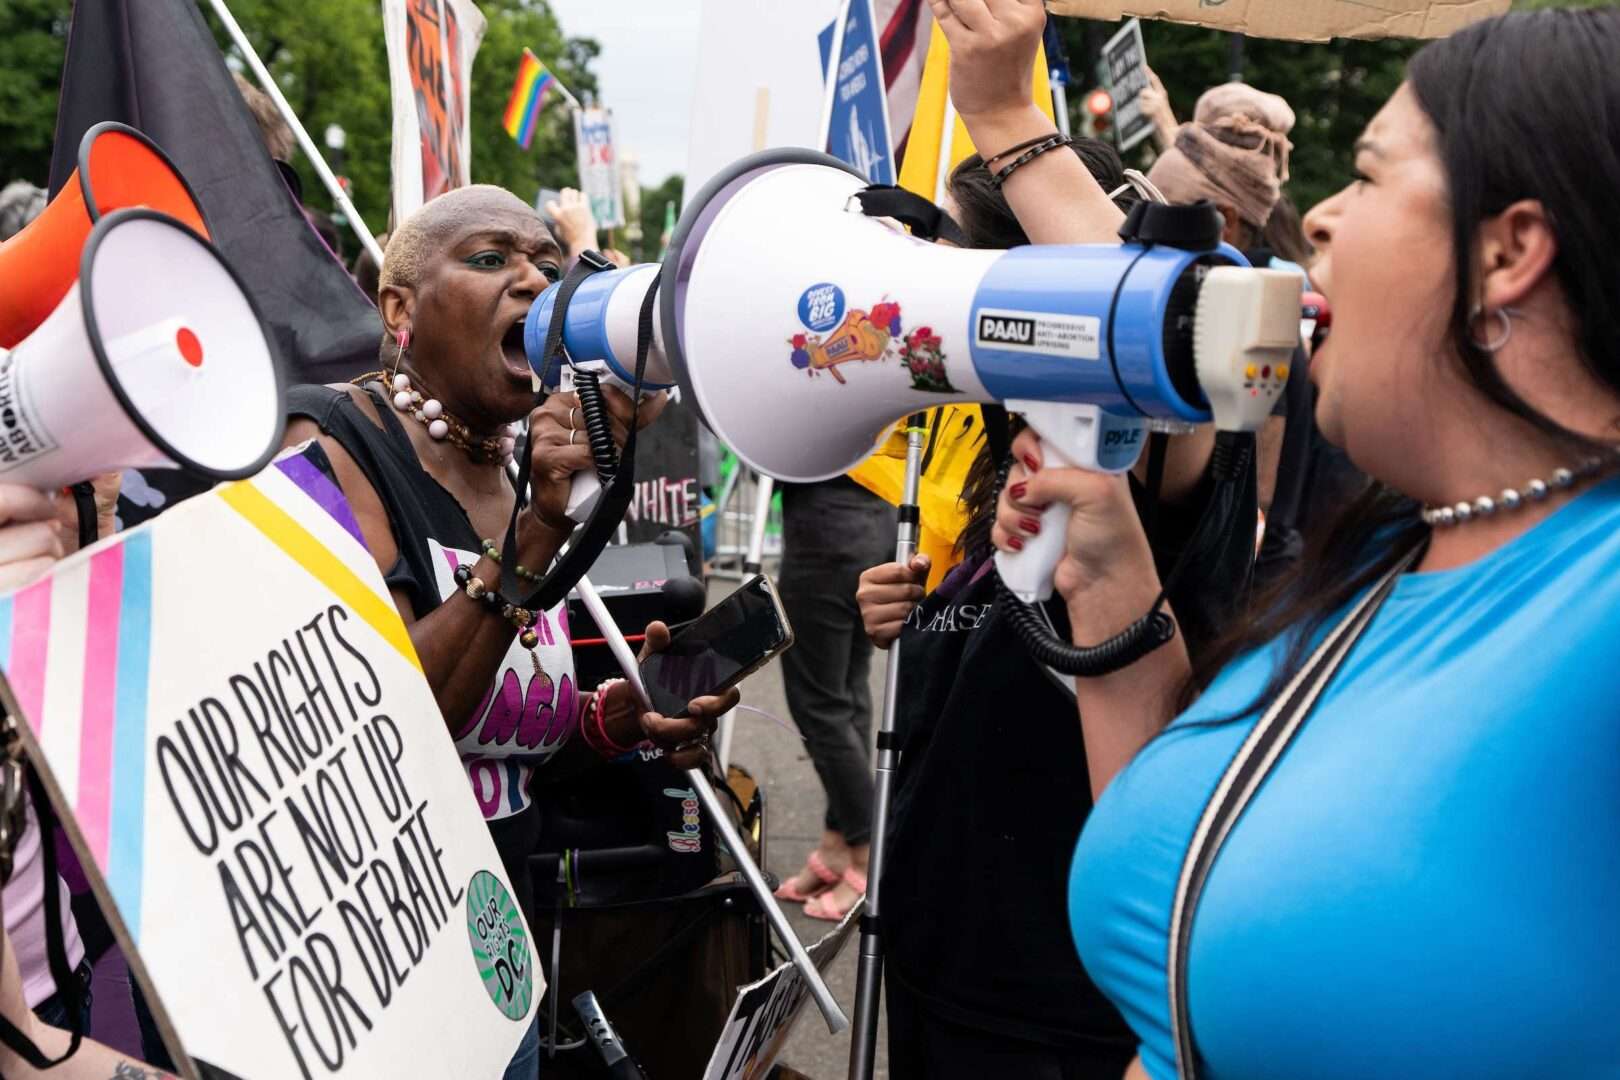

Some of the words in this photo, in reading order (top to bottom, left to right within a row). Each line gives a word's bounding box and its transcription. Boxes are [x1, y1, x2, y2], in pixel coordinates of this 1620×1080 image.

[809, 302, 836, 322] BIG
[982, 318, 1032, 342] PAAU
[1104, 428, 1141, 446] PYLE
[155, 697, 272, 856] OUR
[229, 604, 382, 789] RIGHTS
[217, 810, 323, 982] ARE
[284, 747, 378, 902] NOT
[353, 714, 413, 824] UP
[262, 932, 373, 1080] FOR
[336, 800, 464, 1009] DEBATE
[476, 897, 502, 941] OUR
[485, 918, 511, 959] RIGHTS
[494, 938, 525, 1003] DC
